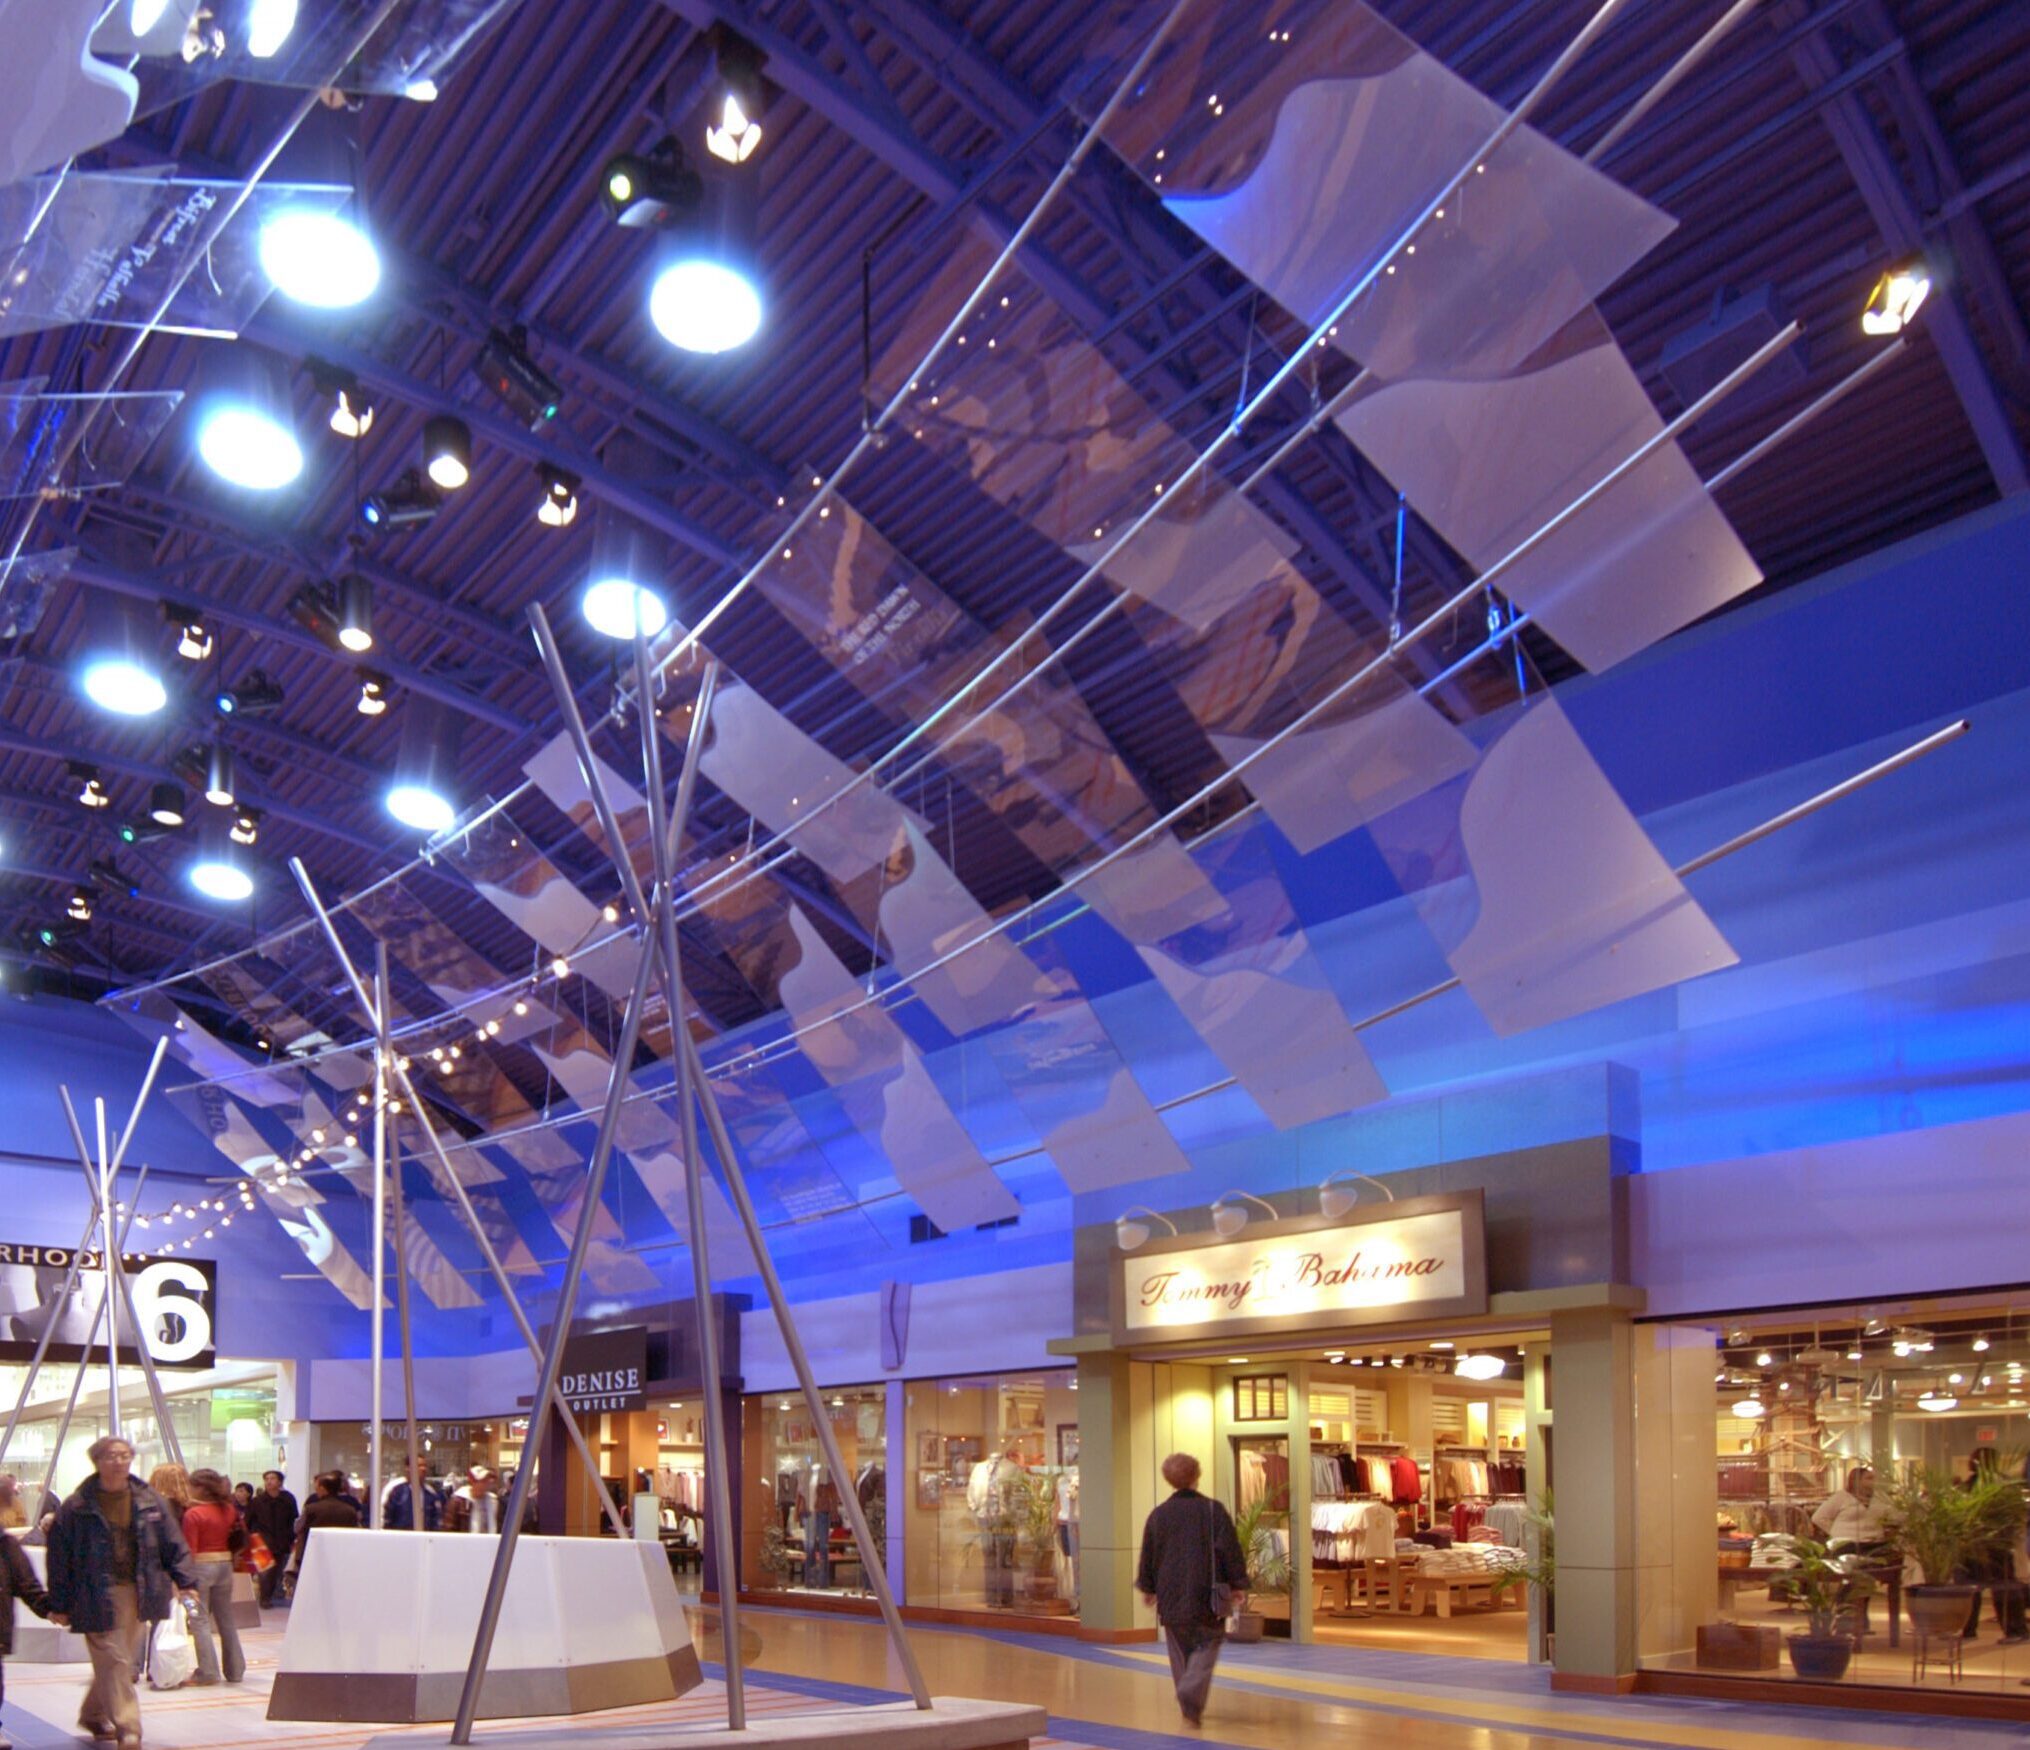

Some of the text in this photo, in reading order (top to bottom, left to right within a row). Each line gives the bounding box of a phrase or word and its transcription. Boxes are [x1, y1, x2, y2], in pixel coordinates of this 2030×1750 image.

[131, 1262, 211, 1362] 6
[562, 1368, 639, 1394] DENISE
[573, 1397, 626, 1411] OUTLET
